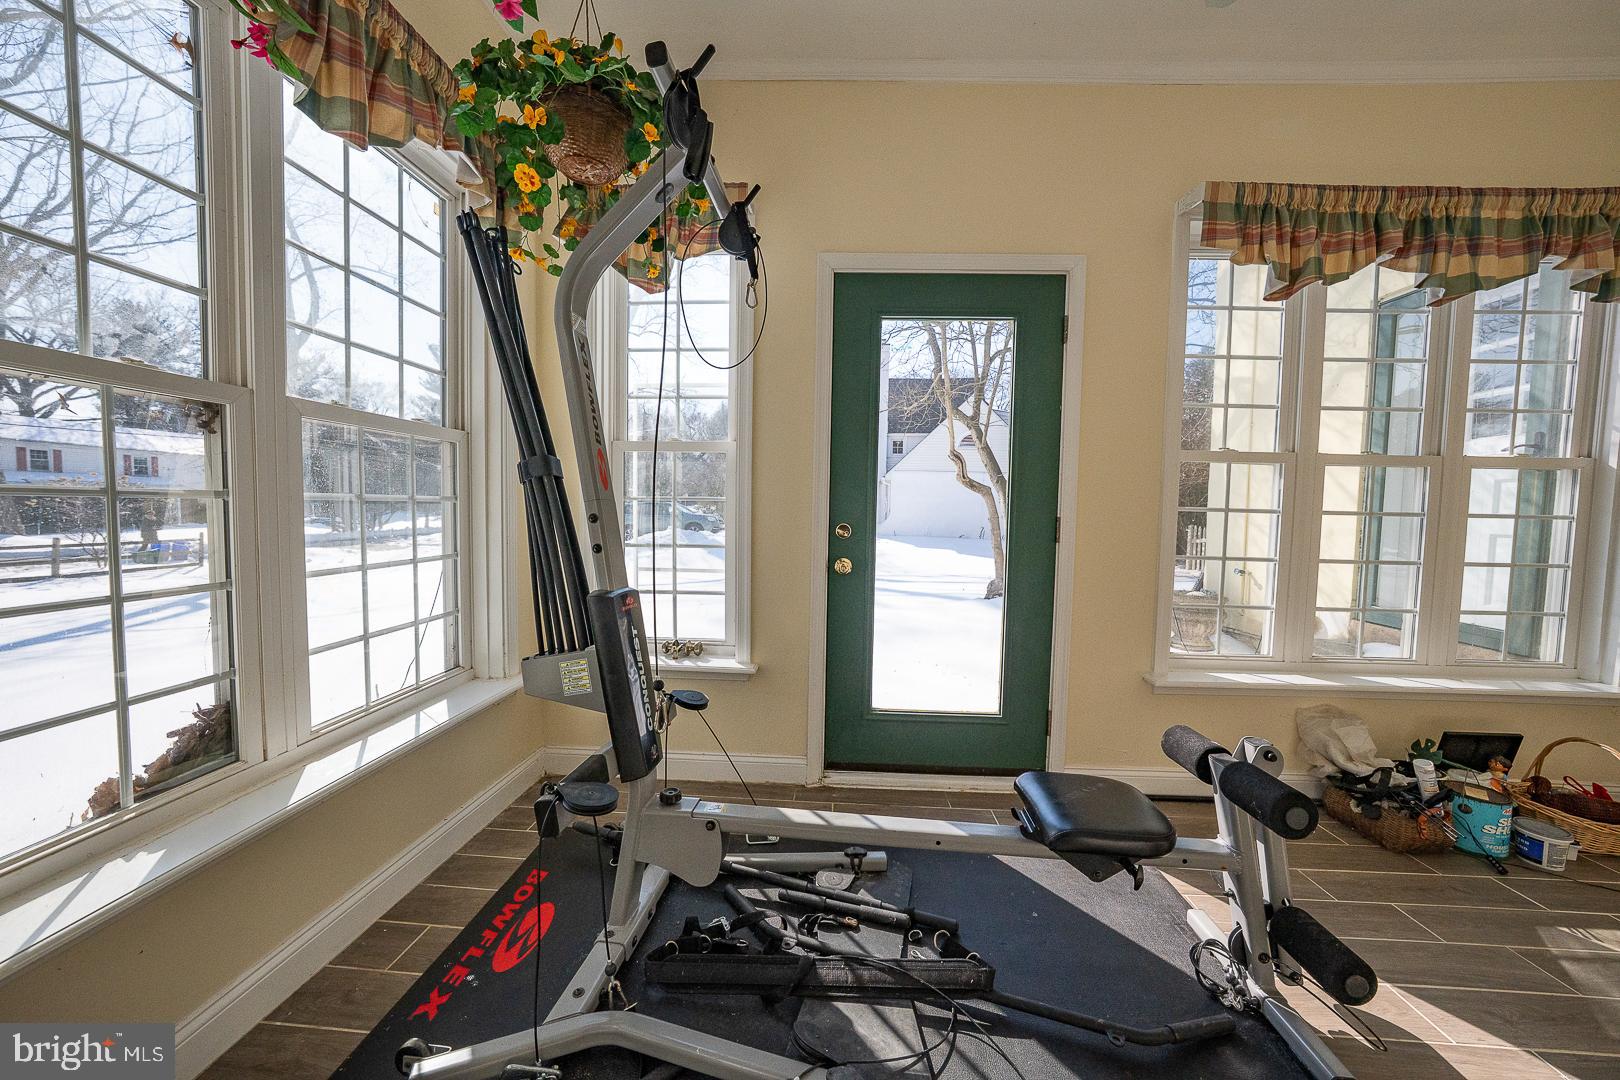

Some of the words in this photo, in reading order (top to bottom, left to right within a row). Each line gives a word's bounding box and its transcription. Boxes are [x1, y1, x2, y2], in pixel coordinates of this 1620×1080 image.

[578, 336, 602, 446] BOWFLEX
[631, 625, 654, 732] CONQUEST
[407, 868, 550, 1022] BOWFLEX
